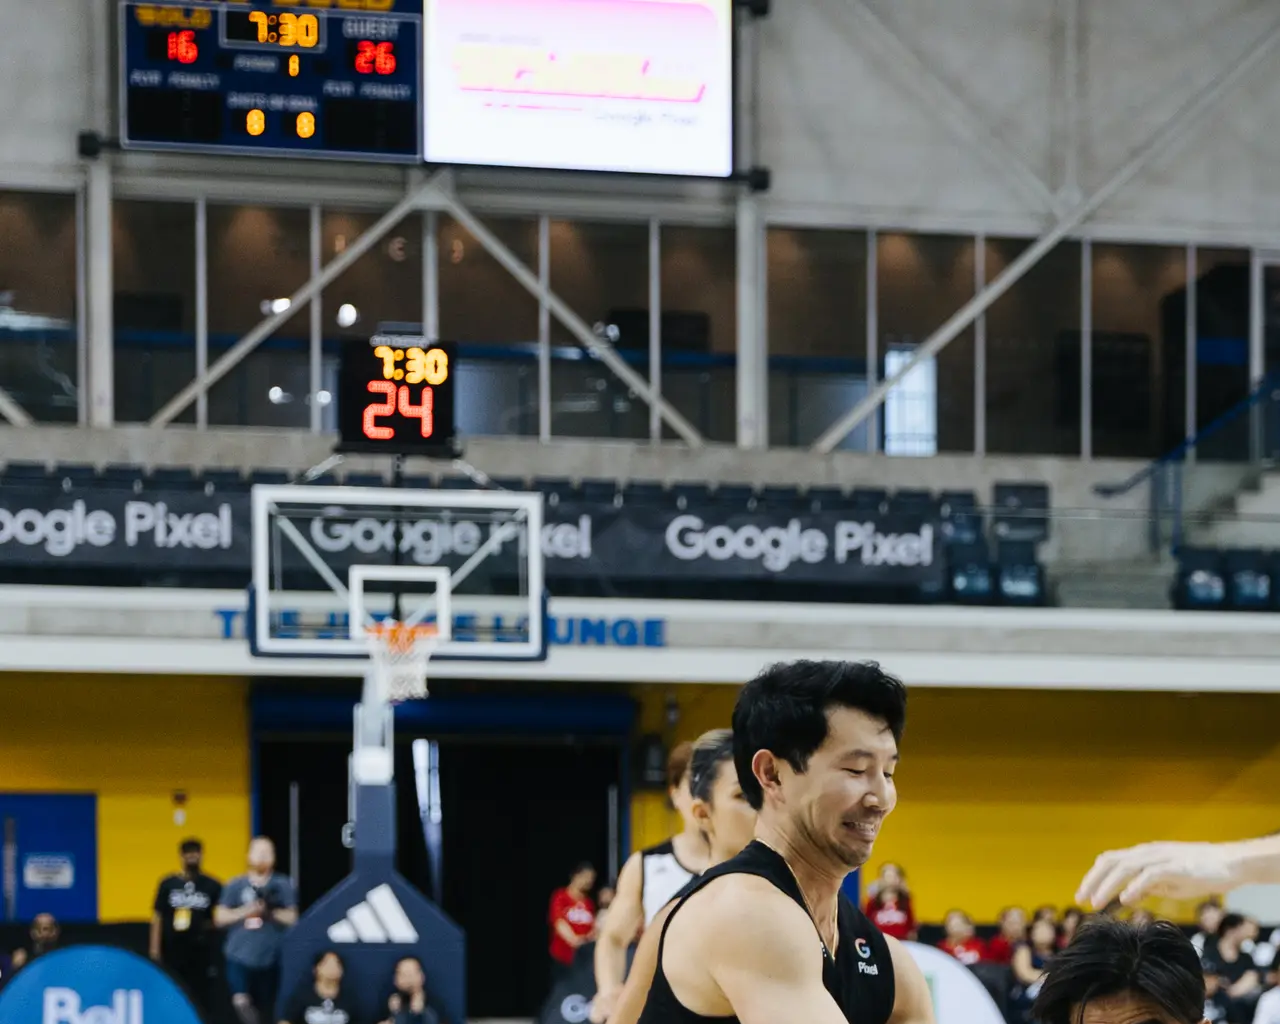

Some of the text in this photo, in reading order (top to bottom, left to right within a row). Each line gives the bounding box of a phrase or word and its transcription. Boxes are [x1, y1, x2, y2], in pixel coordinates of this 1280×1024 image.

[168, 30, 198, 64] 16
[249, 11, 318, 48] 7:30
[355, 40, 396, 75] 26
[374, 345, 449, 385] 7:30
[362, 379, 434, 440] 24
[125, 501, 232, 549] Pixel
[310, 508, 482, 564] Google
[665, 514, 934, 572] Google Pixel
[485, 613, 668, 648] LUNGE
[855, 937, 872, 959] G
[857, 961, 879, 976] Pixel
